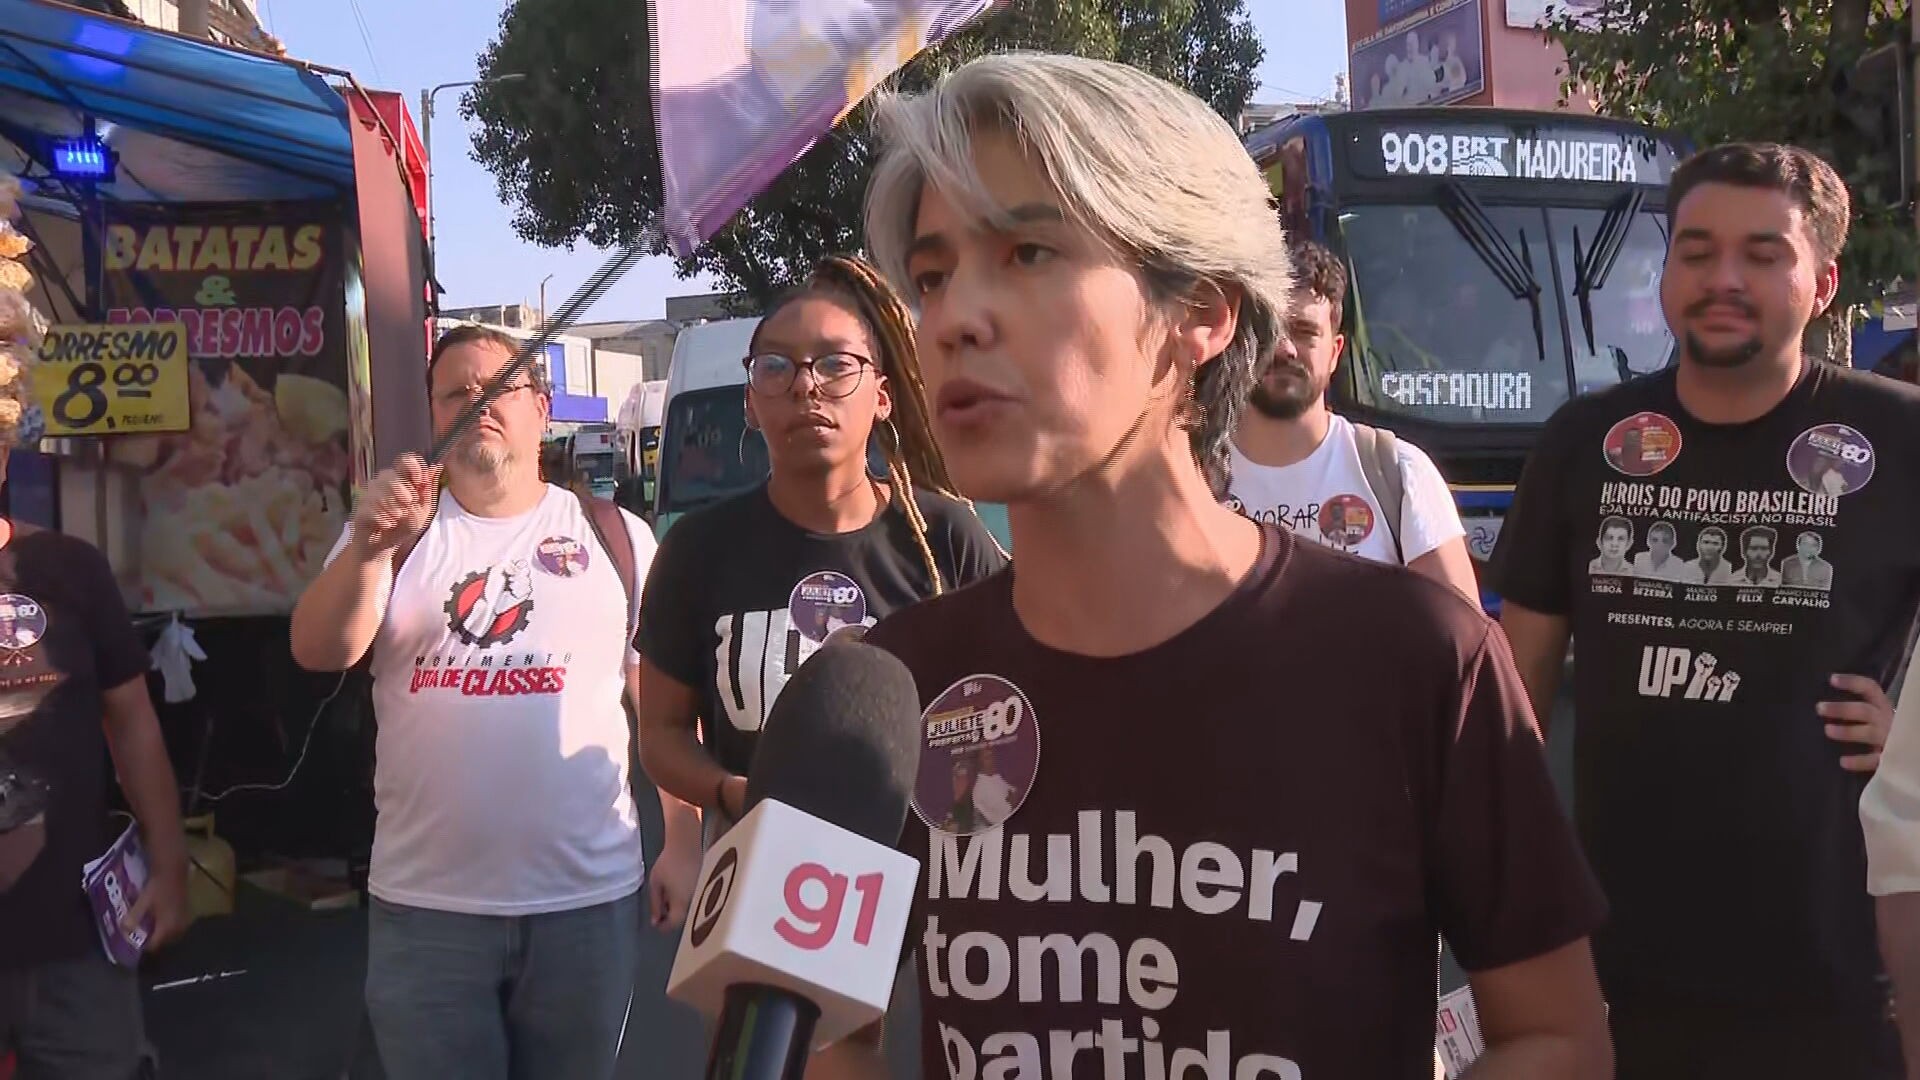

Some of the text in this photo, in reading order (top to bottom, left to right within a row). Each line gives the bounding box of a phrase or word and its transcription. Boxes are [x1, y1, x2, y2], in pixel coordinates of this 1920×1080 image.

[1381, 132, 1637, 182] 908 BRT MADUREIRA
[105, 225, 325, 271] BATATAS
[196, 276, 237, 306] &
[38, 331, 178, 362] ORRESMO
[1381, 372, 1531, 409] CASCADURA
[1841, 443, 1871, 464] 80
[1627, 505, 1660, 518] LUTA
[1662, 508, 1758, 524] ANTIFASCISTA
[1761, 512, 1782, 524] NO
[1785, 514, 1837, 527] BRASIL
[1659, 486, 1682, 509] DO
[1686, 489, 1731, 513] POVO
[1736, 490, 1840, 517] BRASILEIRO
[833, 586, 858, 604] 80
[1736, 593, 1763, 603] FELIX
[1772, 595, 1831, 609] CARVALHO
[1607, 611, 1793, 635] PRESENTES, AGORA E SEMPRE!
[415, 652, 572, 666] MOVIMENTO
[1638, 645, 1691, 697] UP
[440, 668, 464, 688] DE
[461, 667, 567, 695] CLASSES
[929, 712, 985, 737] JULIETE
[982, 695, 1023, 741] 80
[927, 809, 1323, 941] Mulher,
[773, 862, 885, 951] g1
[922, 915, 1179, 1011] tome
